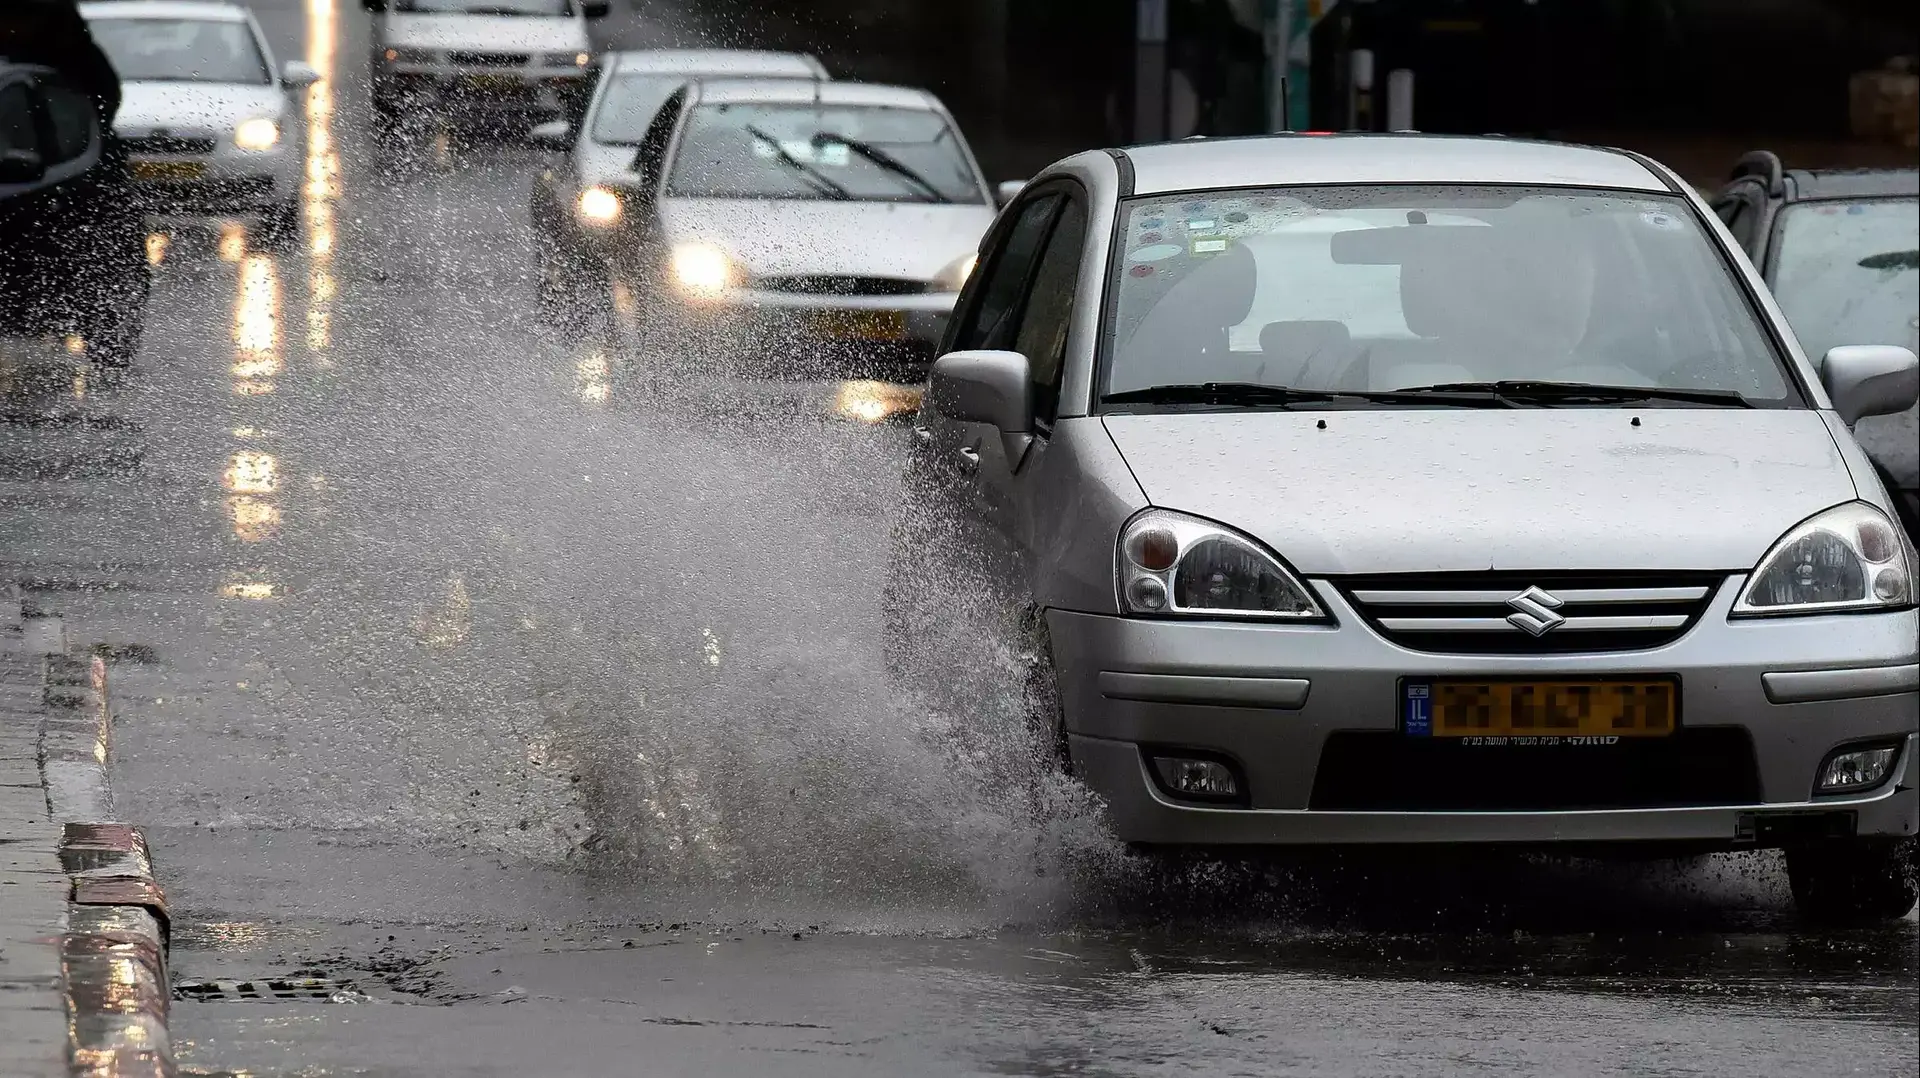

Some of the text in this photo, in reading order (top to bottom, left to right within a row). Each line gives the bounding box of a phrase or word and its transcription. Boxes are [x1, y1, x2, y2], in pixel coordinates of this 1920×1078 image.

[1412, 699, 1427, 720] IL
[1510, 736, 1538, 746] מכשירי
[1567, 736, 1619, 745] סוזוקי
